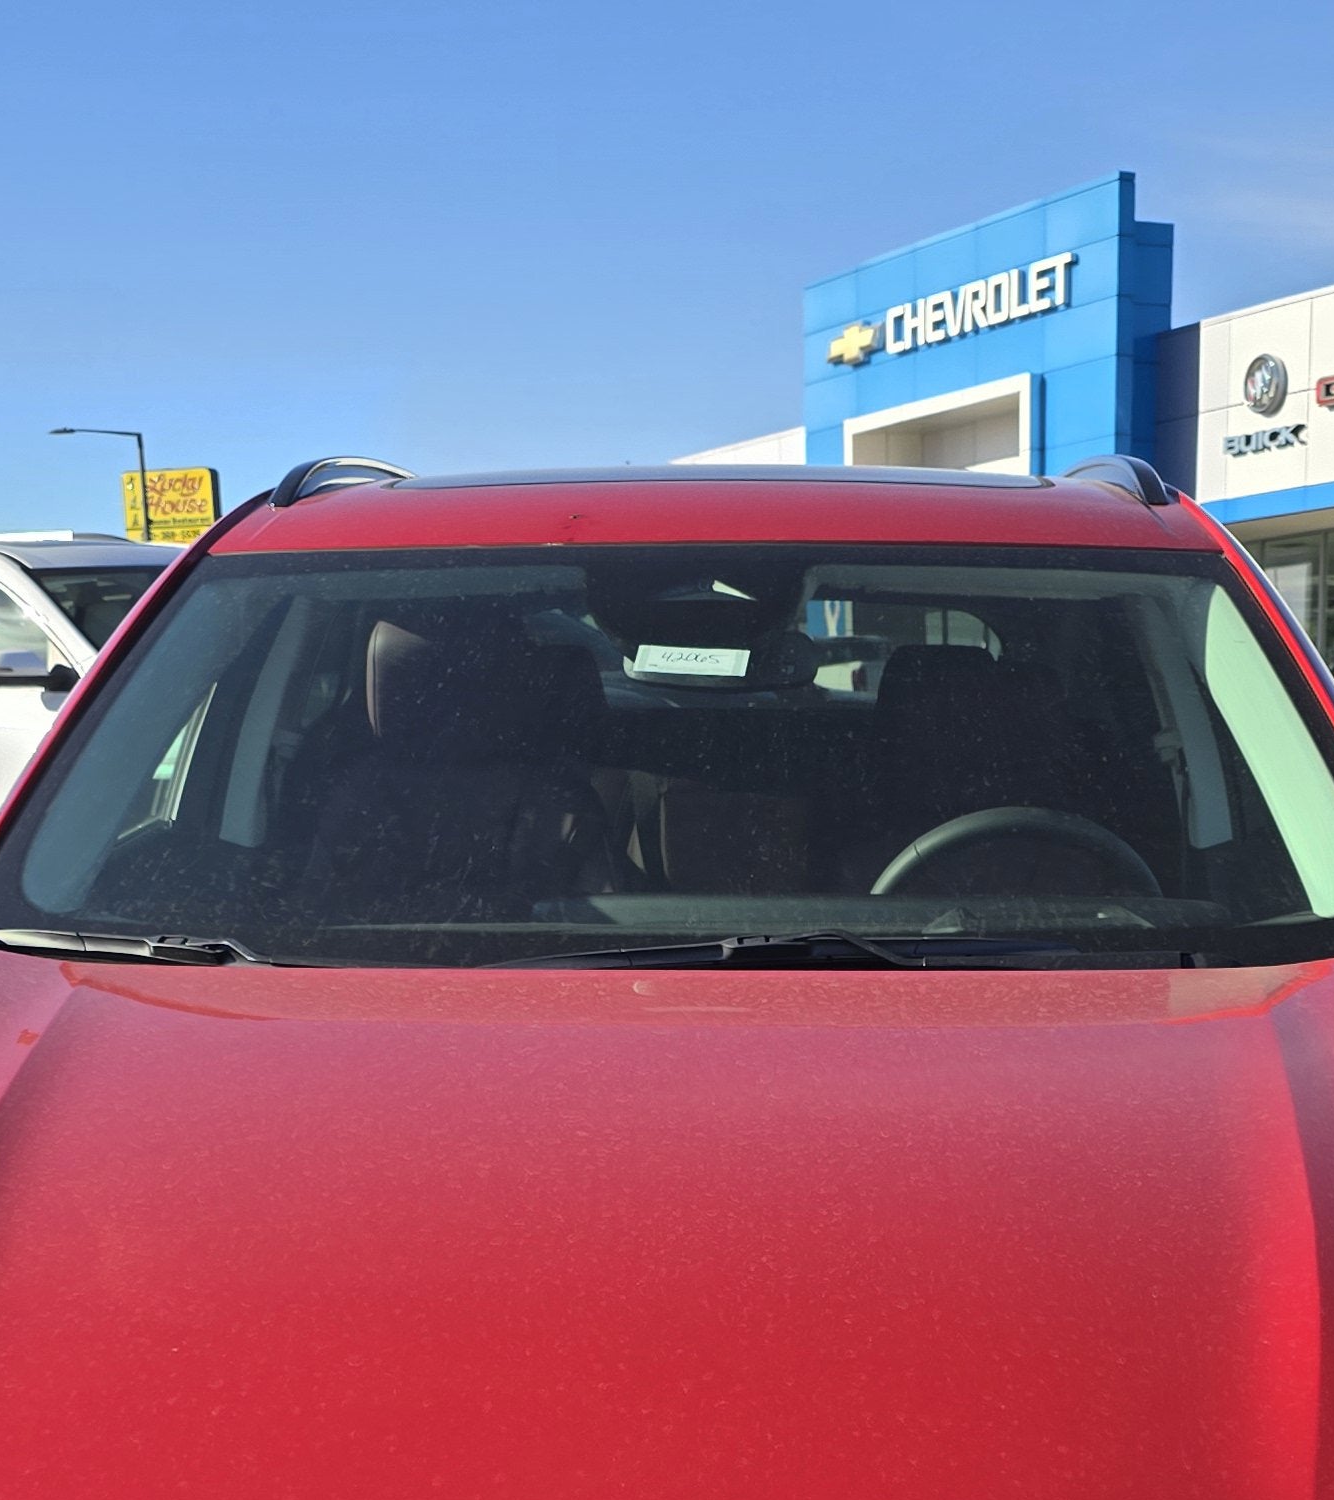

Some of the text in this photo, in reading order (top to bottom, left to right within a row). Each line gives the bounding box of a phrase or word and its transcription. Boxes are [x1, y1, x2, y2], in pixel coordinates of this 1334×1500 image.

[885, 251, 1077, 355] CHEVROLET
[1223, 424, 1306, 457] BUICK
[147, 473, 204, 497] Lucky
[147, 496, 208, 516] House
